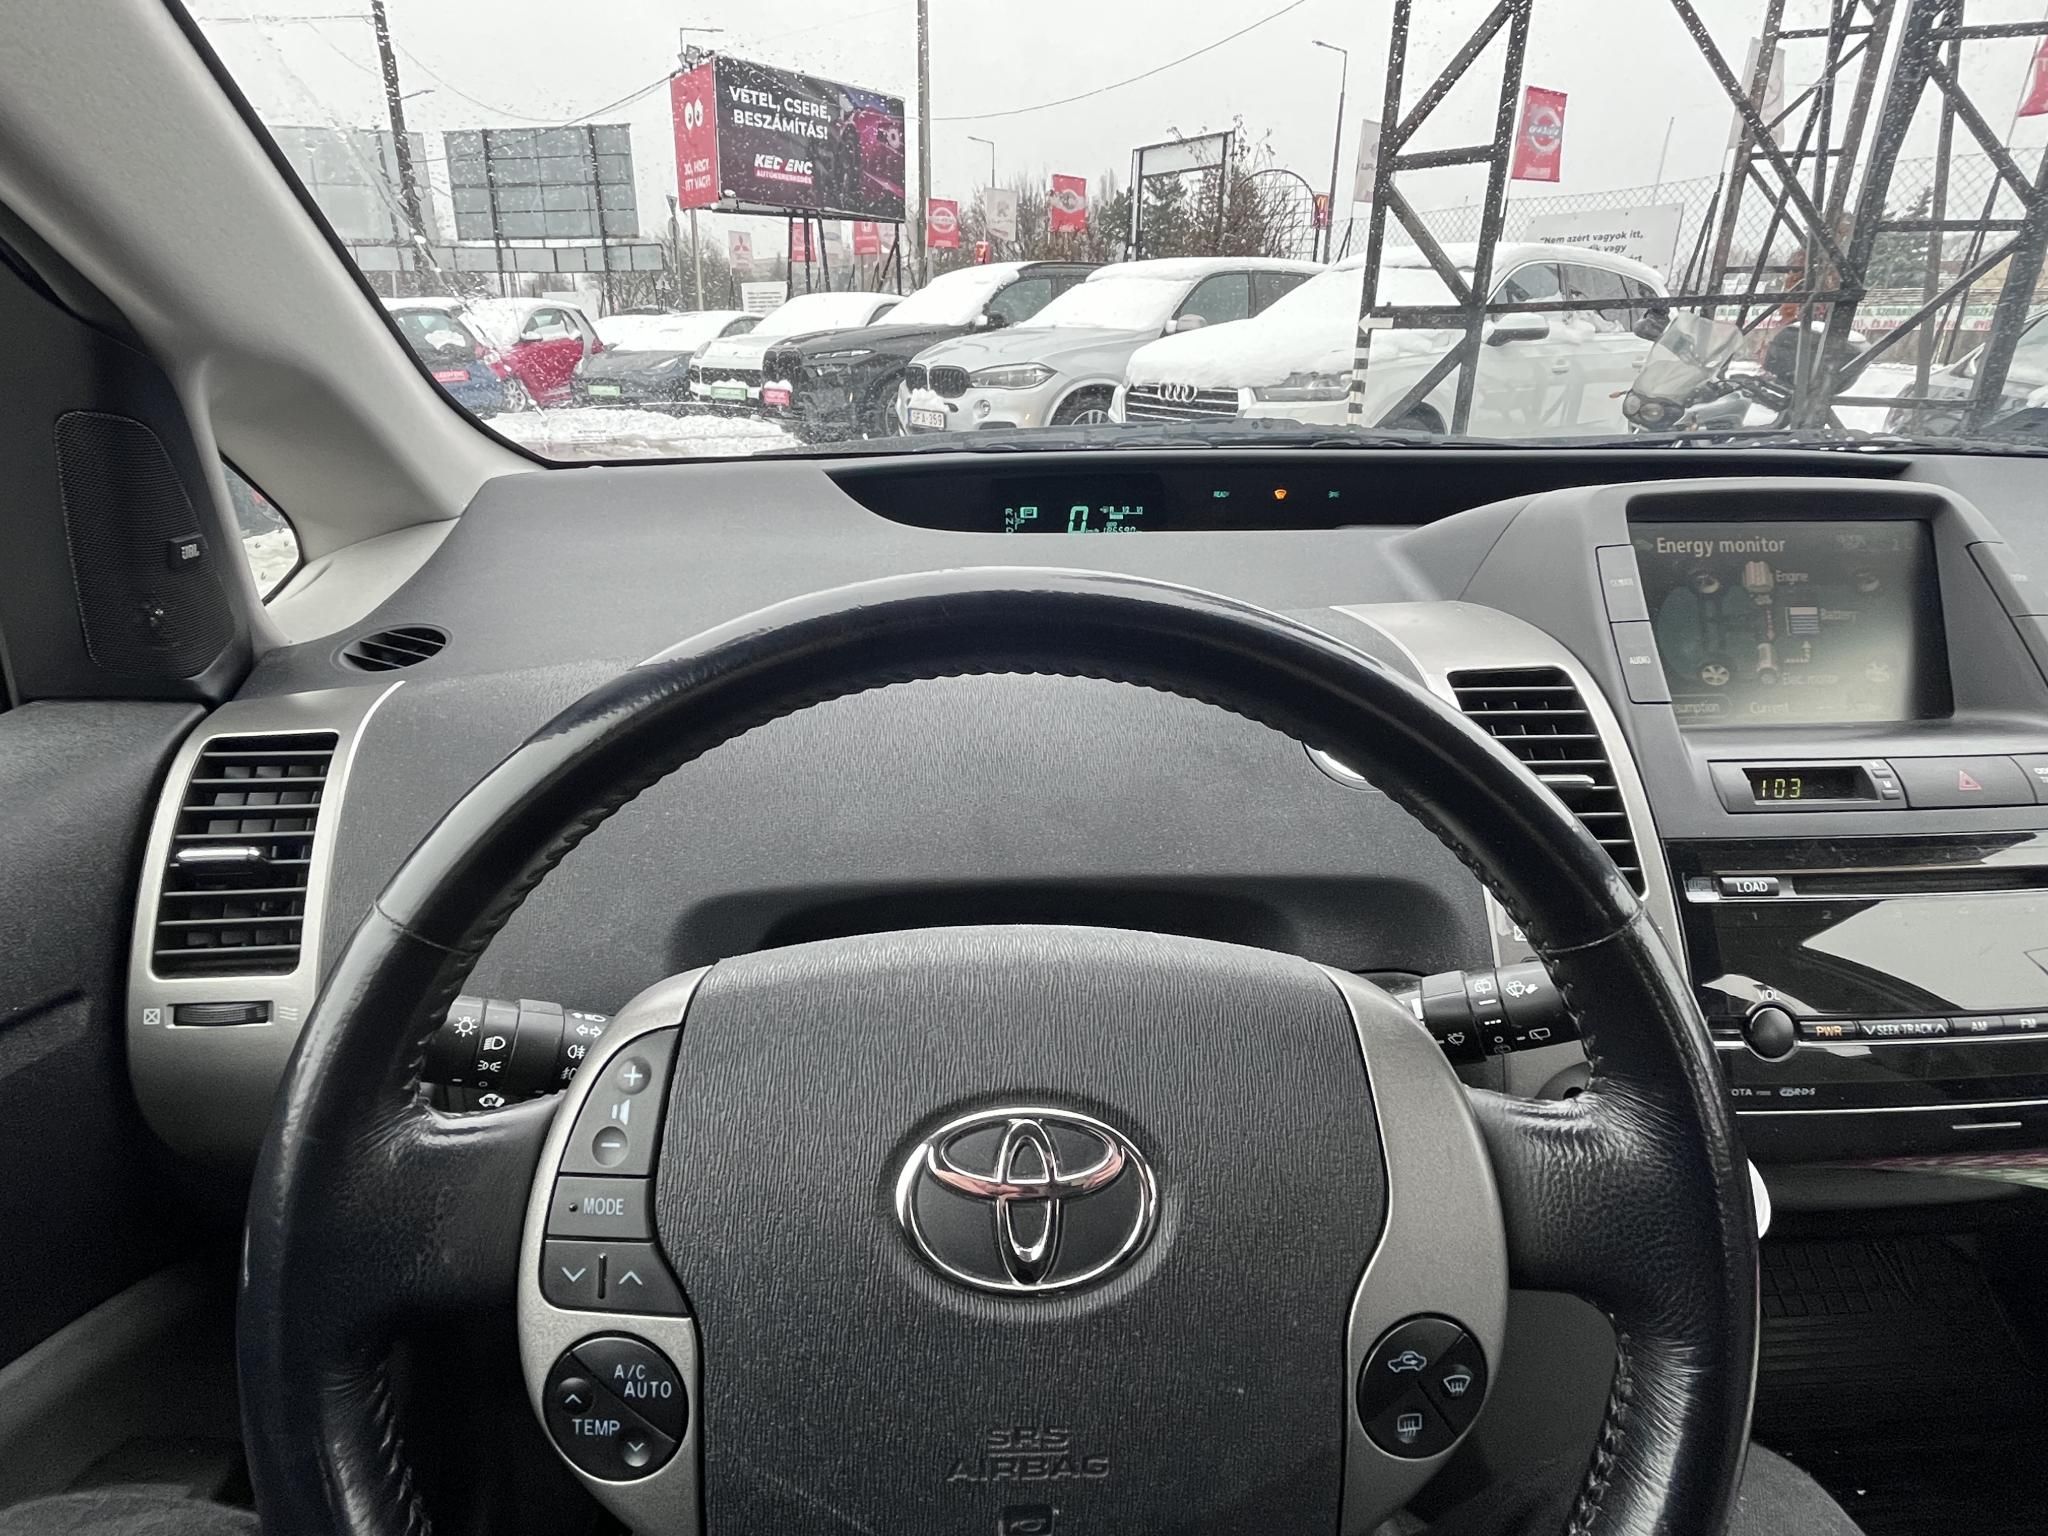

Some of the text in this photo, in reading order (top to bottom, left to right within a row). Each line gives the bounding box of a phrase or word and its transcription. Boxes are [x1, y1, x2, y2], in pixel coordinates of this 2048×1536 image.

[728, 85, 831, 122] VÉTEL, CSERE,
[733, 109, 828, 140] BESZÁMÍTÁS!
[1566, 233, 1590, 243] azért
[1592, 231, 1627, 243] vagyok
[1603, 244, 1628, 254] vagy
[1656, 536, 1786, 558] Energy monitor
[1776, 569, 1809, 584] Engine
[1736, 881, 1769, 893] LOAD
[1822, 910, 1833, 920] 2
[1757, 989, 1781, 1001] VOL
[1815, 1025, 1842, 1036] PWR
[1971, 1020, 1988, 1032] AM
[2020, 1018, 2036, 1029] FM
[583, 1197, 625, 1217] MODE
[614, 1364, 647, 1380] A/C
[624, 1381, 673, 1399] AUTO
[572, 1418, 621, 1436] TEMP
[987, 1429, 1069, 1449] SRS
[947, 1457, 1112, 1482] AIRBAG
